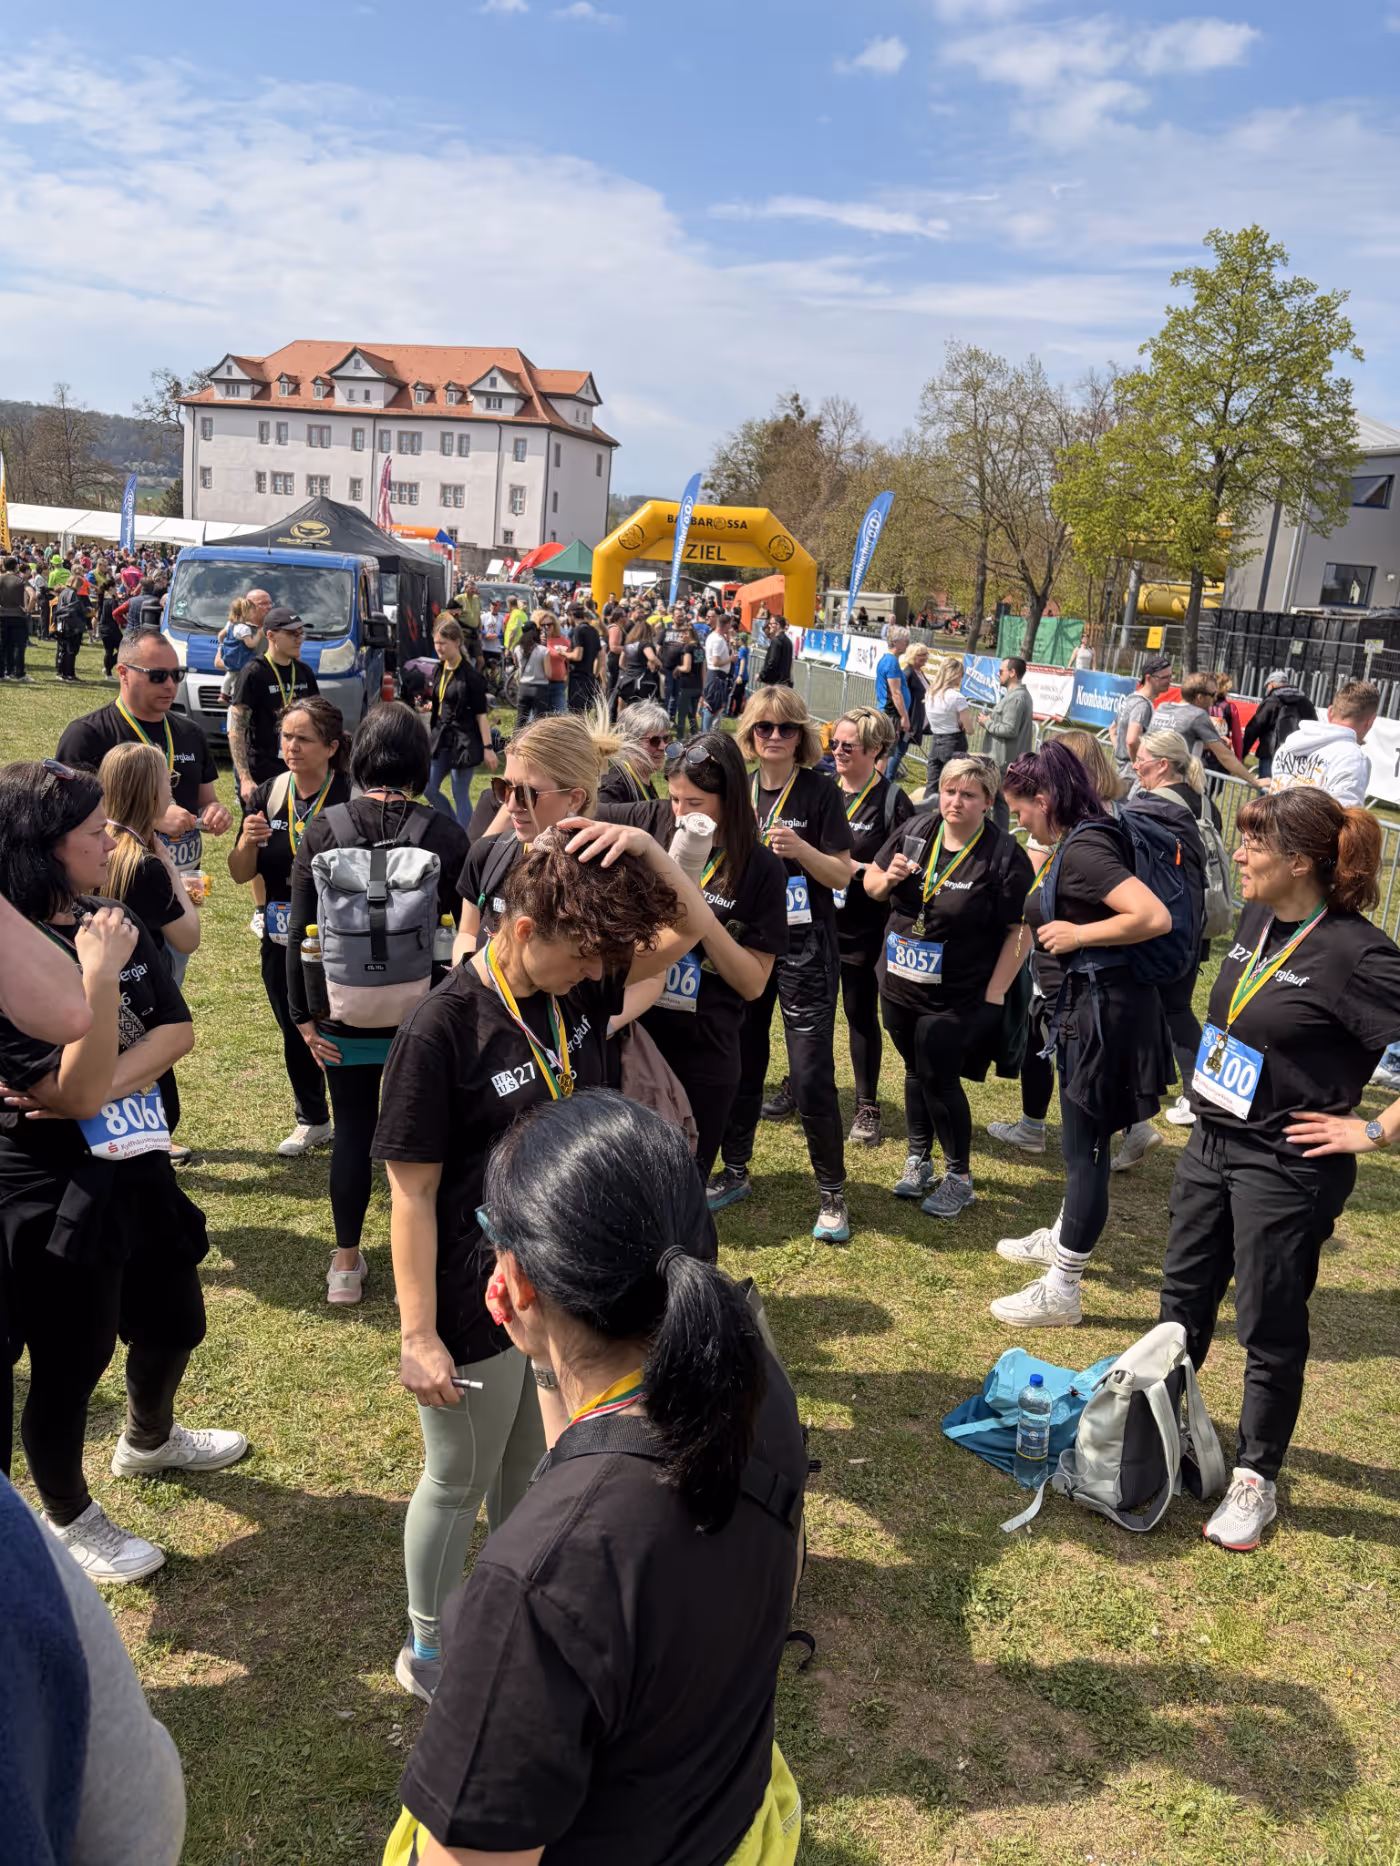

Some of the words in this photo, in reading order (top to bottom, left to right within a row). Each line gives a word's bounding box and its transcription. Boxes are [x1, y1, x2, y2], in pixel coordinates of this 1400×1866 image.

[685, 544, 727, 561] ZIEL
[1076, 684, 1115, 712] Krombacher
[168, 841, 202, 865] 8037
[943, 880, 974, 890] erglauf
[786, 887, 808, 912] 09
[895, 945, 942, 974] 8057
[667, 963, 696, 996] 06
[1275, 969, 1310, 988] rglauf
[513, 1061, 536, 1085] 27
